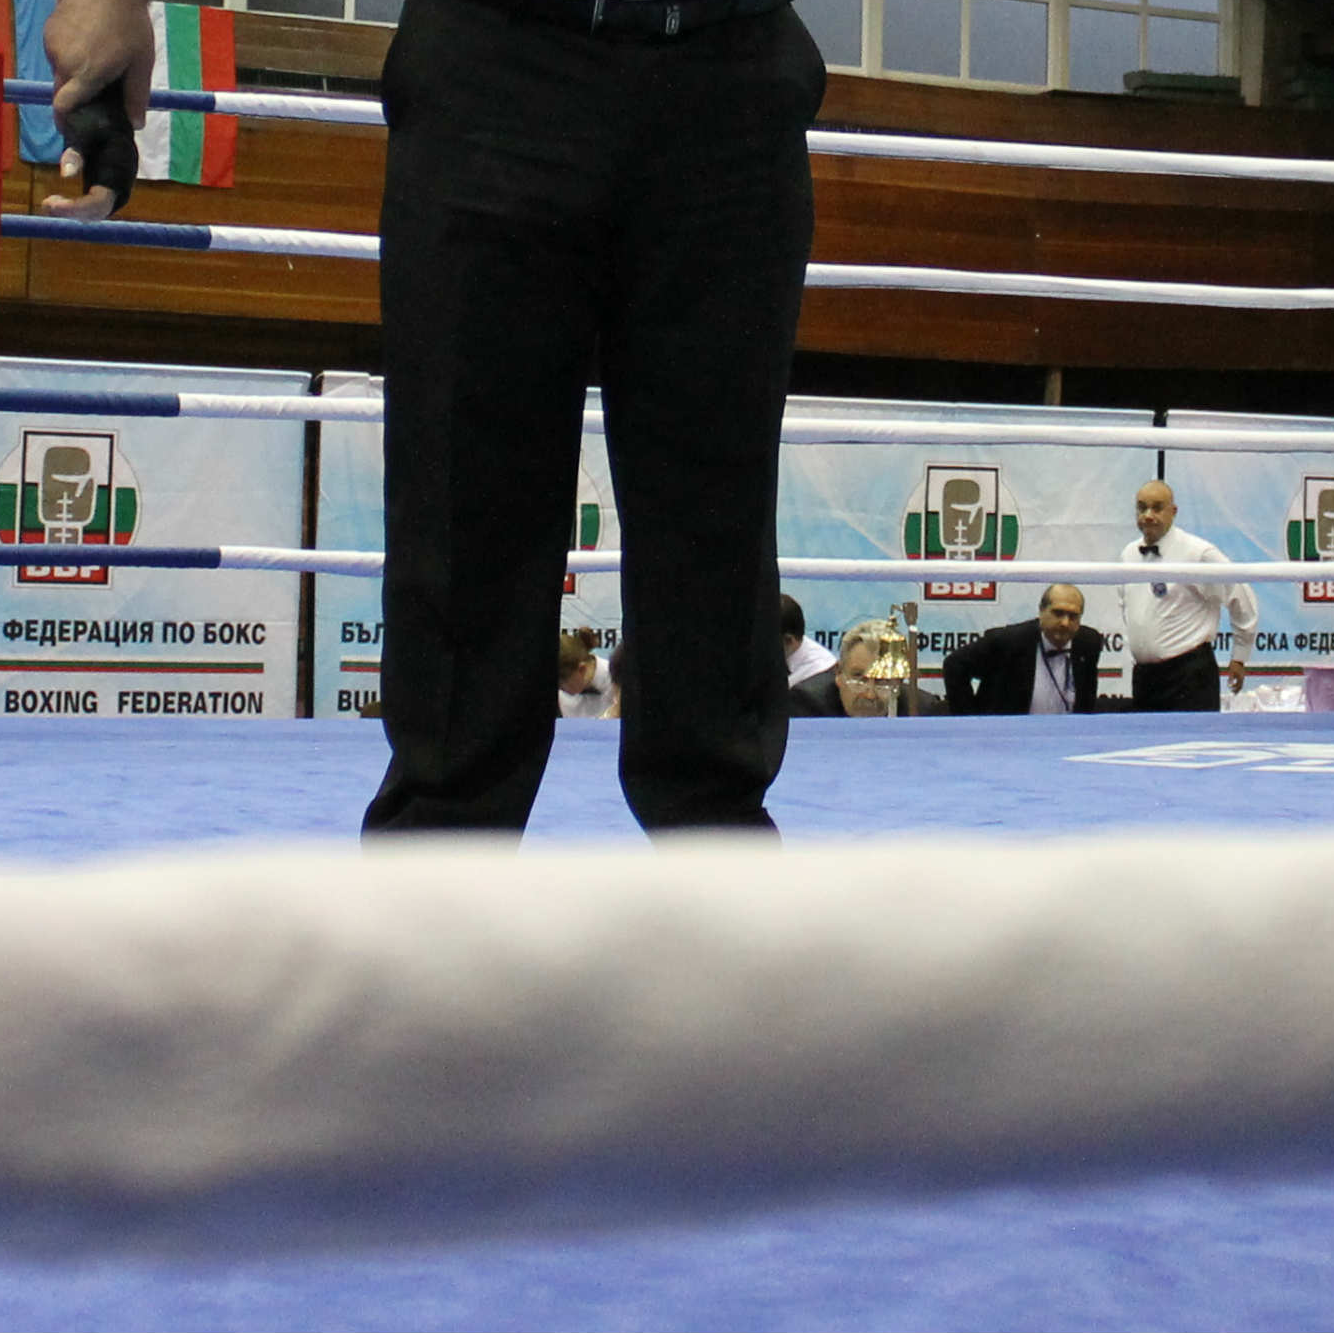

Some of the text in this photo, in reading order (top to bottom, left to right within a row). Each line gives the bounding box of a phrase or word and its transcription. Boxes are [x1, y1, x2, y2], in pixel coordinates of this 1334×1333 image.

[2, 619, 153, 647] ФЕДЕРАЦИЯ
[162, 621, 196, 644] ПО
[203, 622, 266, 645] БОКС
[5, 690, 98, 714] BOXING
[118, 691, 264, 715] FEDERATION
